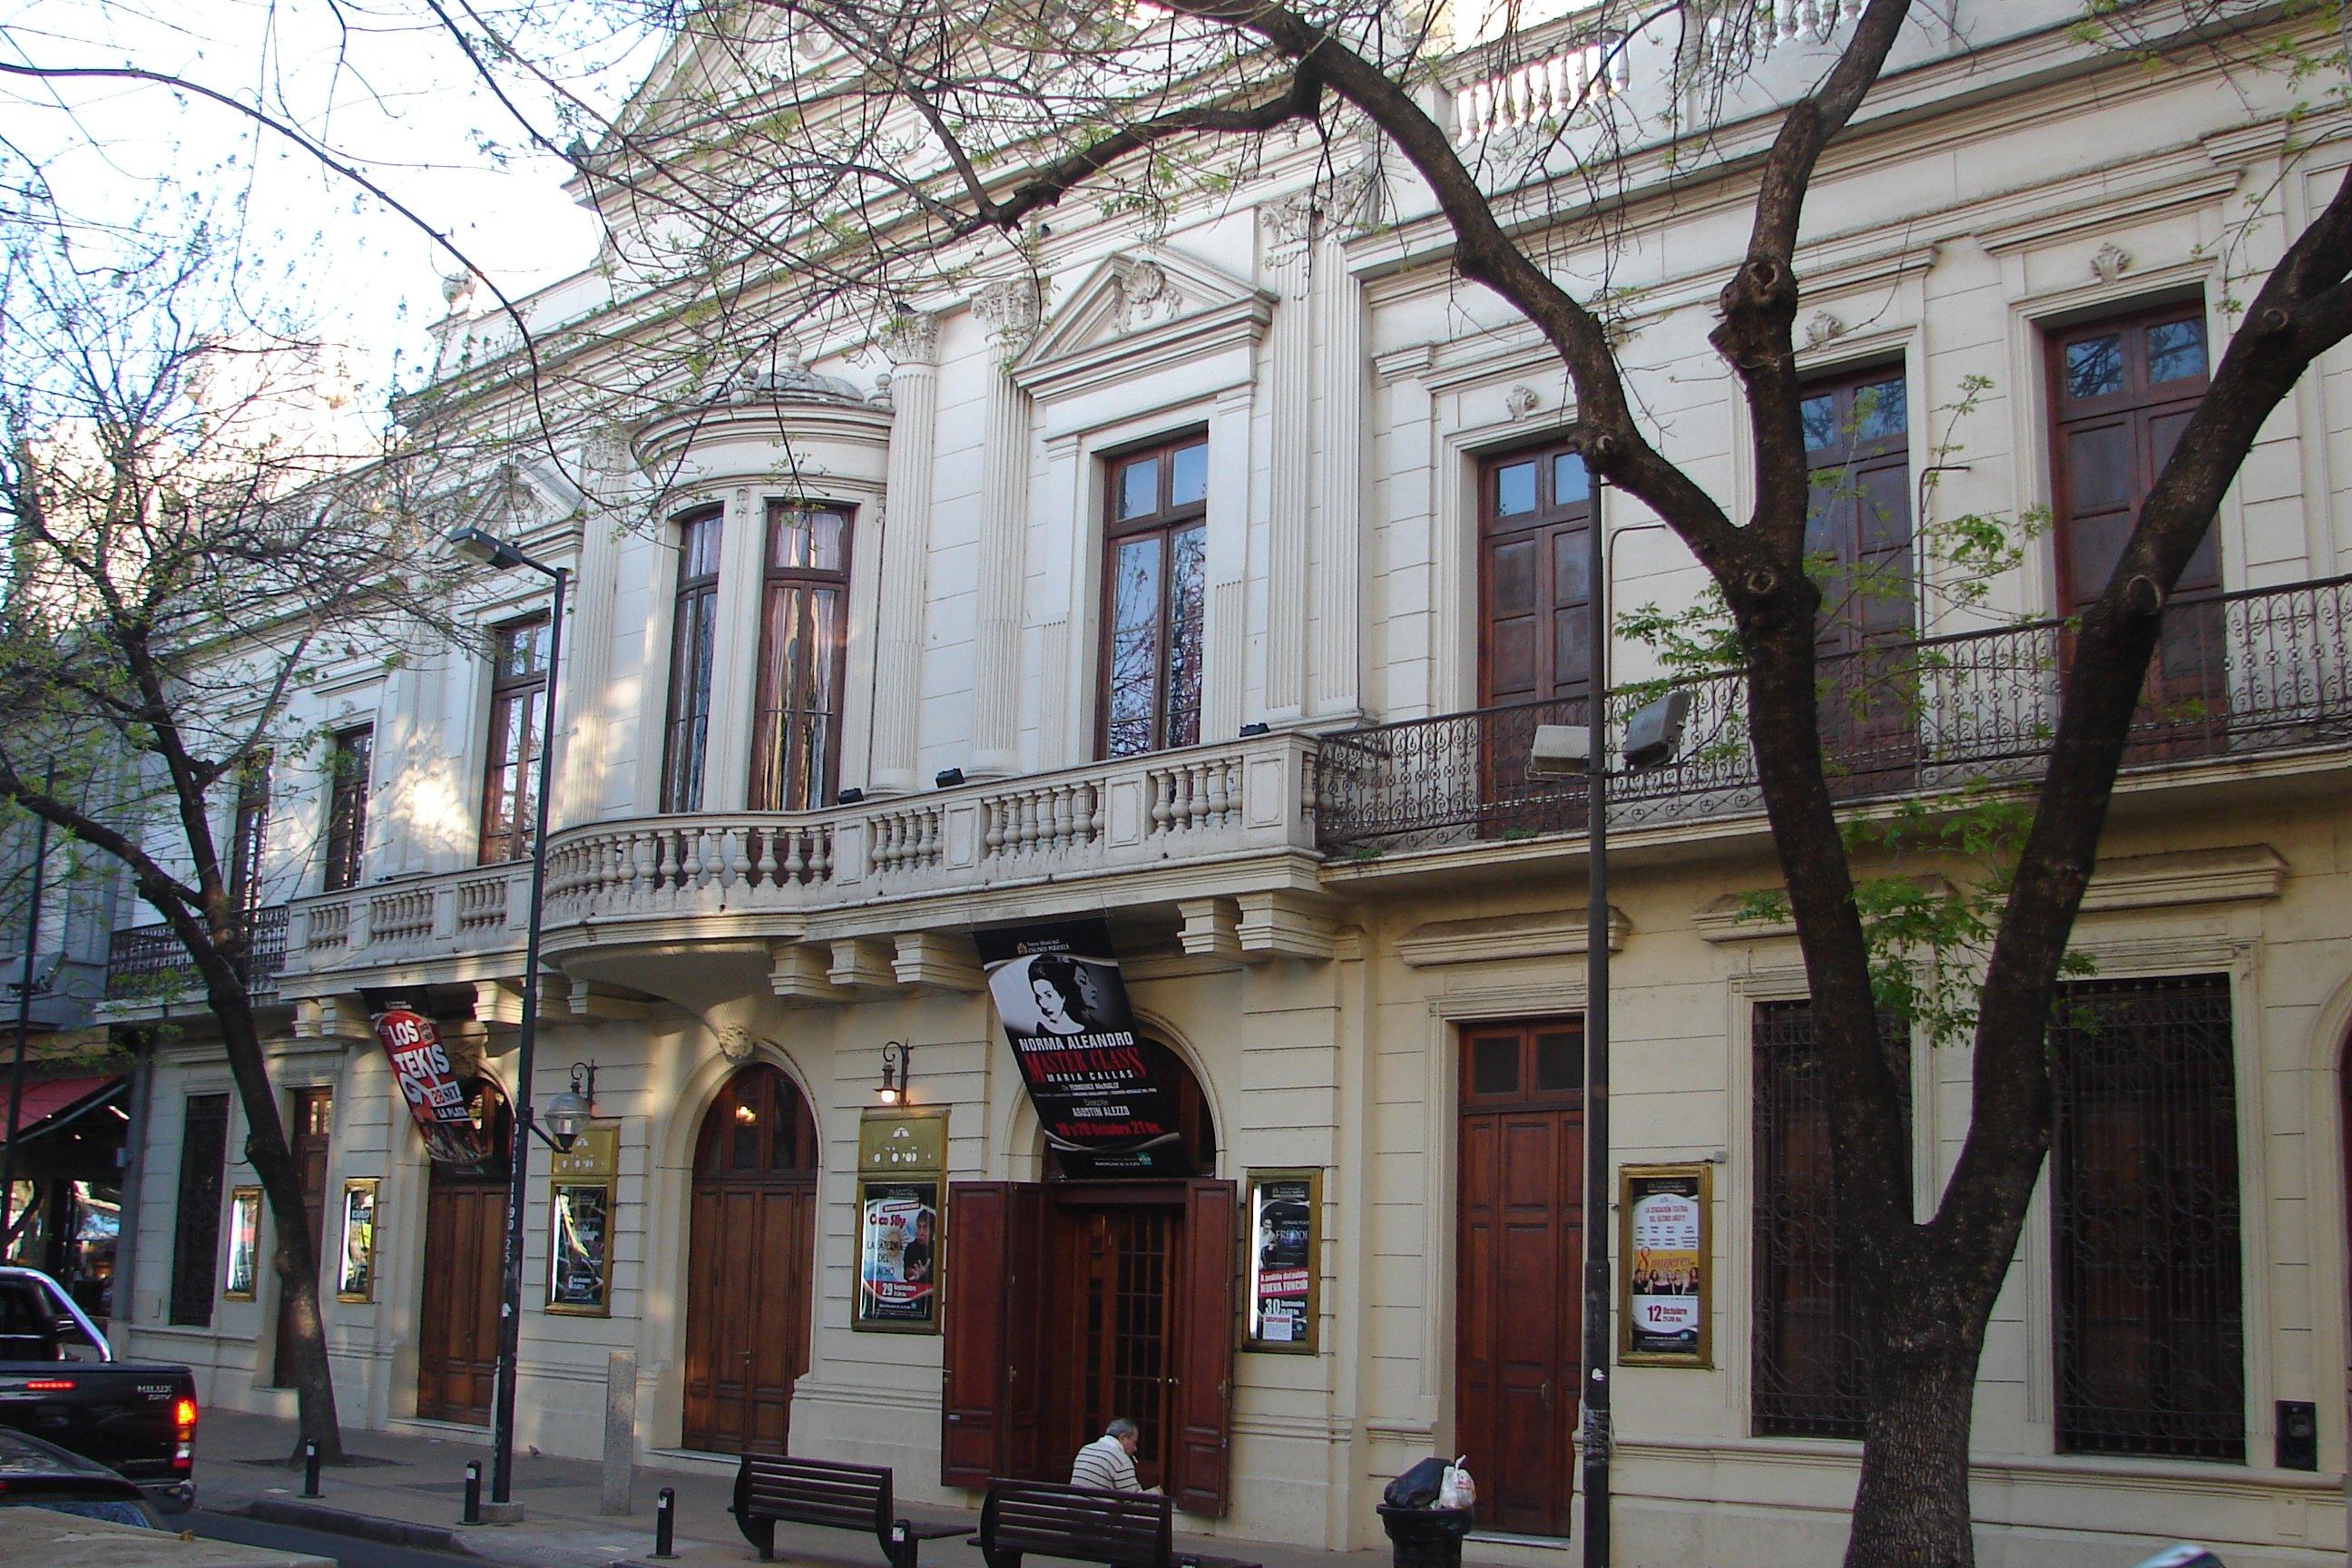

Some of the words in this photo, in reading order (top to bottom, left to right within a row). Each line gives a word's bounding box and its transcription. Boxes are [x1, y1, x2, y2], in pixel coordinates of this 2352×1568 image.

[387, 1019, 420, 1047] LOS
[1018, 1037, 1065, 1052] NORMA
[1067, 1031, 1134, 1050] ALEANDRO
[392, 1044, 451, 1080] TEKIS
[1024, 1050, 1088, 1083] MASTER
[1089, 1046, 1147, 1079] CLASS
[1046, 1072, 1083, 1083] MARIA
[1090, 1069, 1134, 1080] CALLAS
[869, 1213, 888, 1225] Cco
[1638, 1246, 1651, 1269] 8
[882, 1282, 893, 1297] 29
[1265, 1298, 1280, 1315] 30
[1647, 1305, 1661, 1322] 12
[137, 1385, 172, 1393] HILUX
